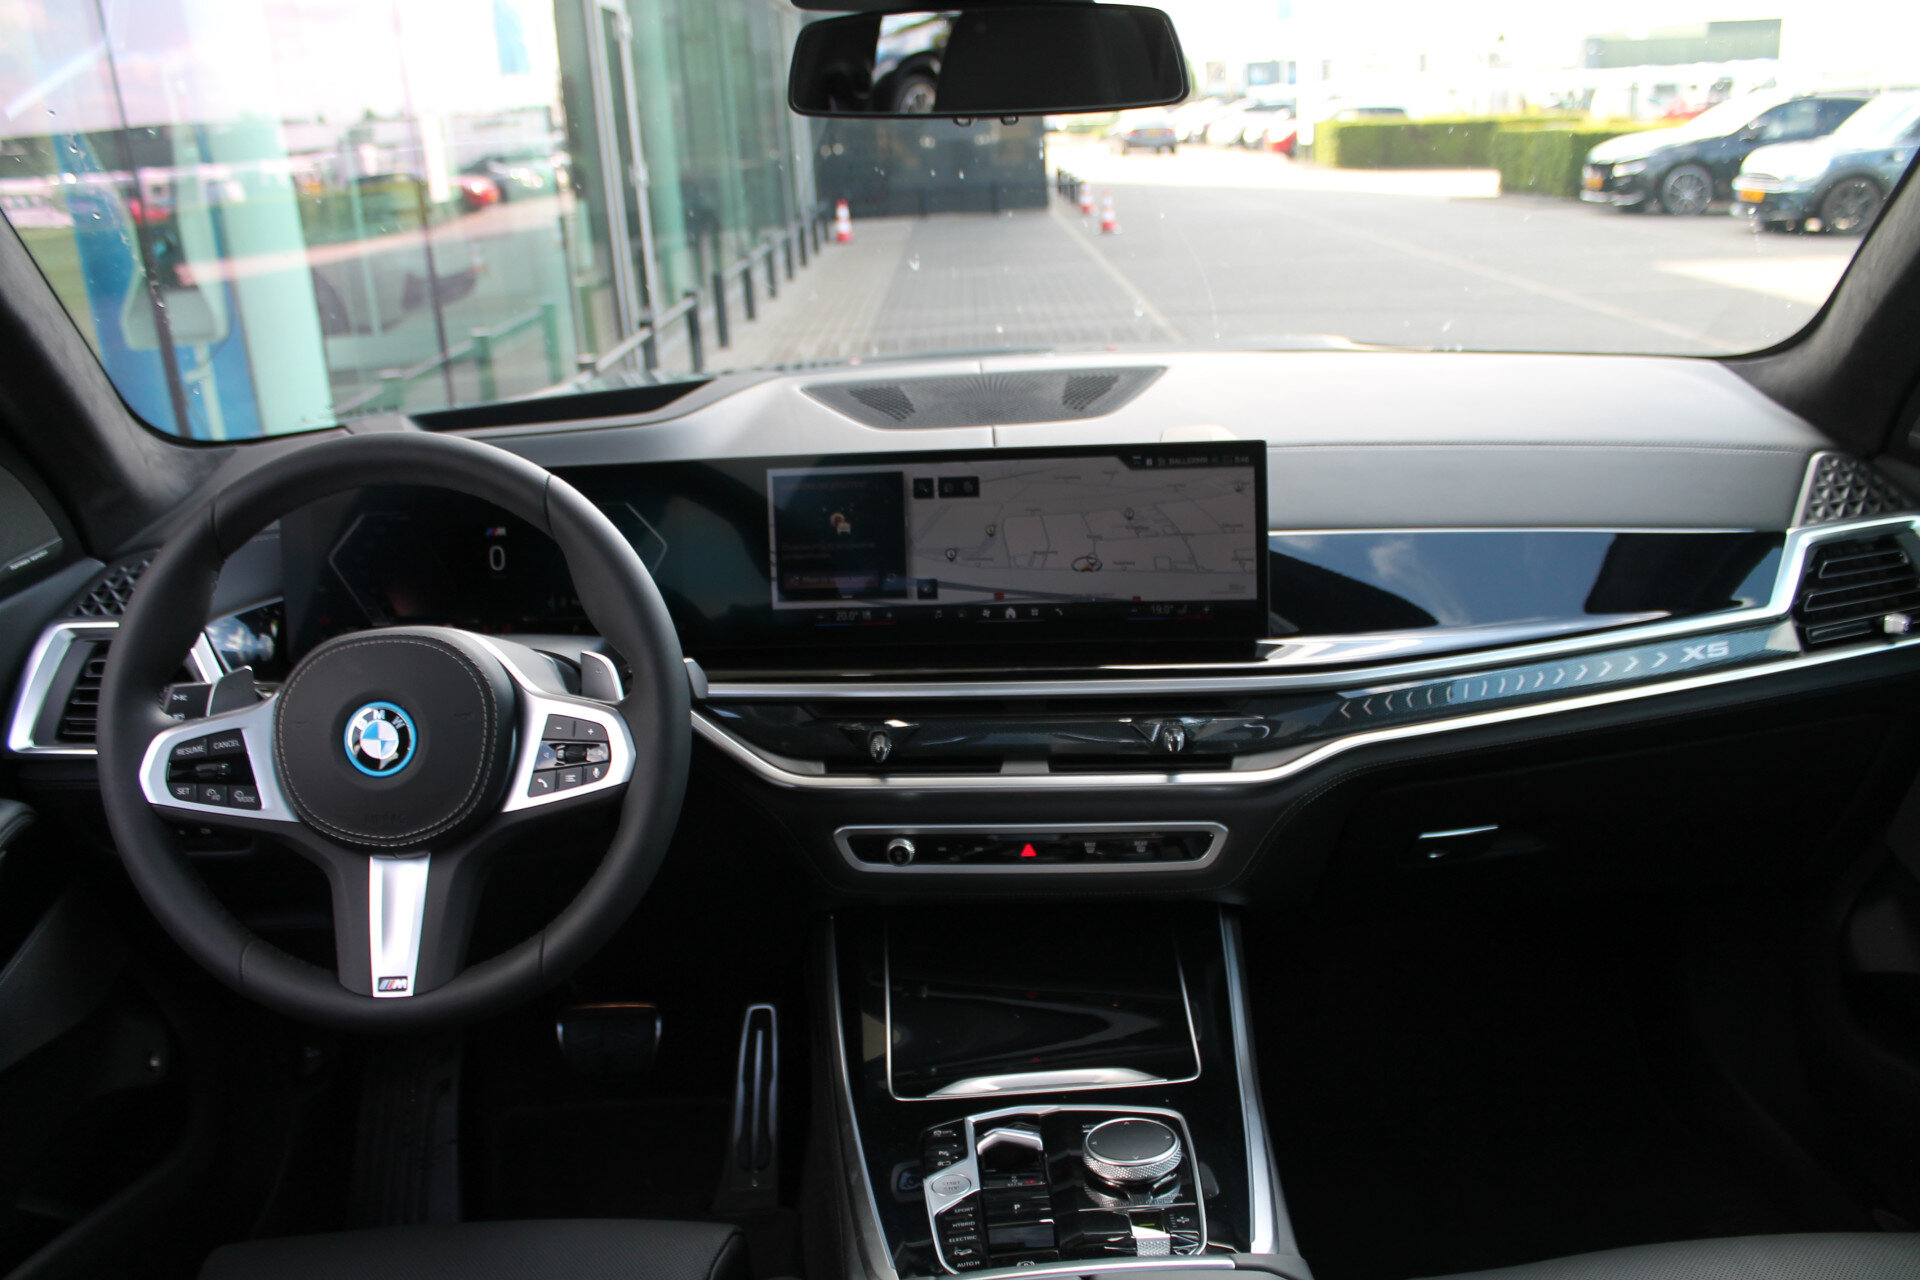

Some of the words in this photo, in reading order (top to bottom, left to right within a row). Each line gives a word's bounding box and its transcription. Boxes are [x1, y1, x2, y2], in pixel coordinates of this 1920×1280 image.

[489, 545, 506, 571] 0
[1680, 640, 1730, 663] X5
[352, 709, 406, 731] BMW
[212, 739, 241, 750] CANCEL
[176, 745, 206, 756] RESUME
[176, 787, 190, 795] SET
[952, 1220, 976, 1228] HYBRID
[949, 1235, 977, 1243] ELECTRIC
